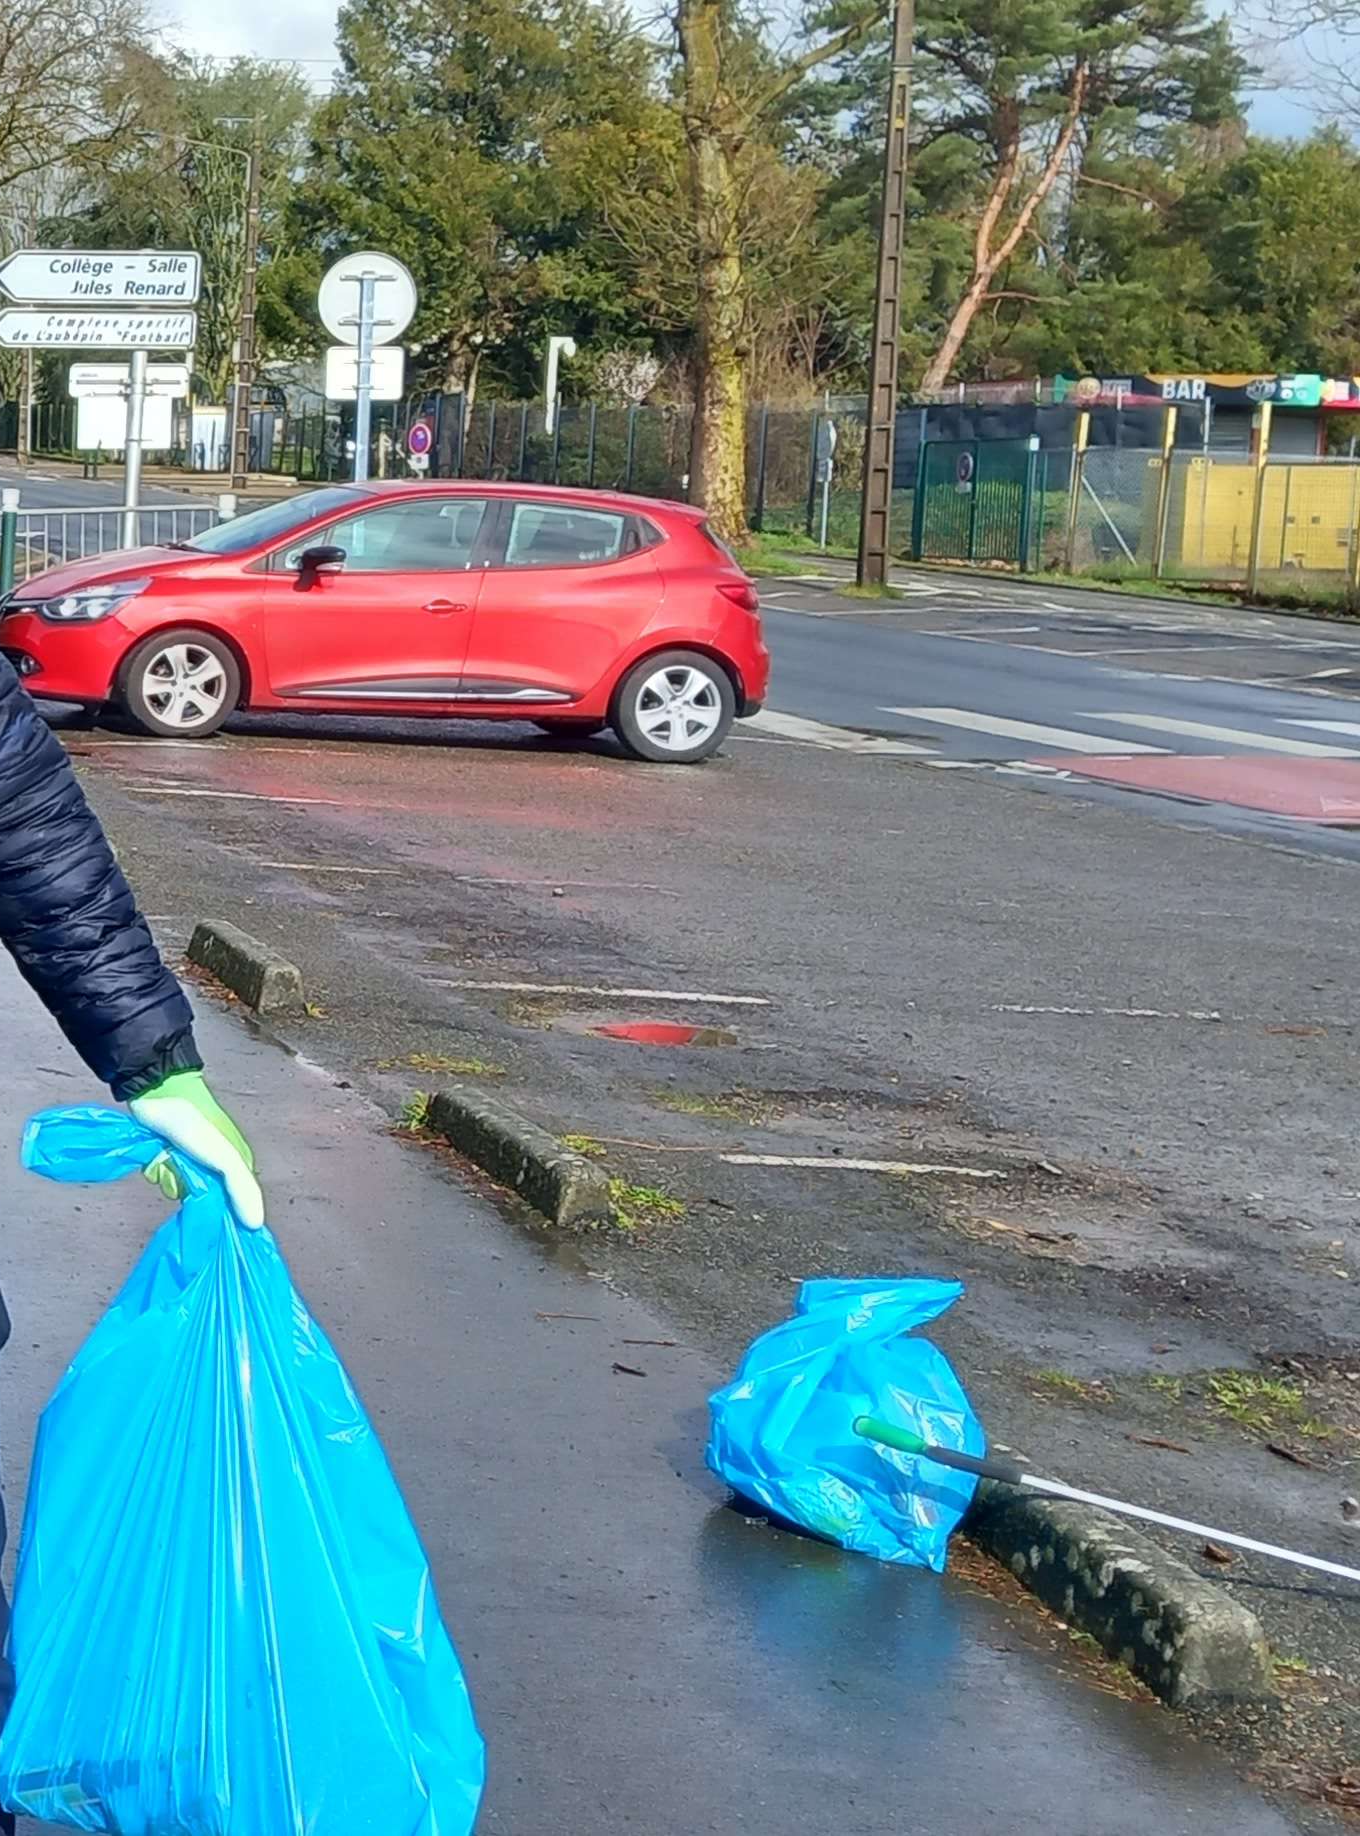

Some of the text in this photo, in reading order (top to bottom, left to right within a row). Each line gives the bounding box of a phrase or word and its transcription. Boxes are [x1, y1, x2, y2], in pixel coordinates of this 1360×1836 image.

[49, 258, 113, 277] Collège
[147, 258, 188, 273] Salle
[70, 280, 187, 295] Jules Renard
[47, 315, 186, 330] Complexe sportif
[12, 329, 29, 341] de
[117, 331, 190, 343] "Football"
[1162, 378, 1206, 400] BAR
